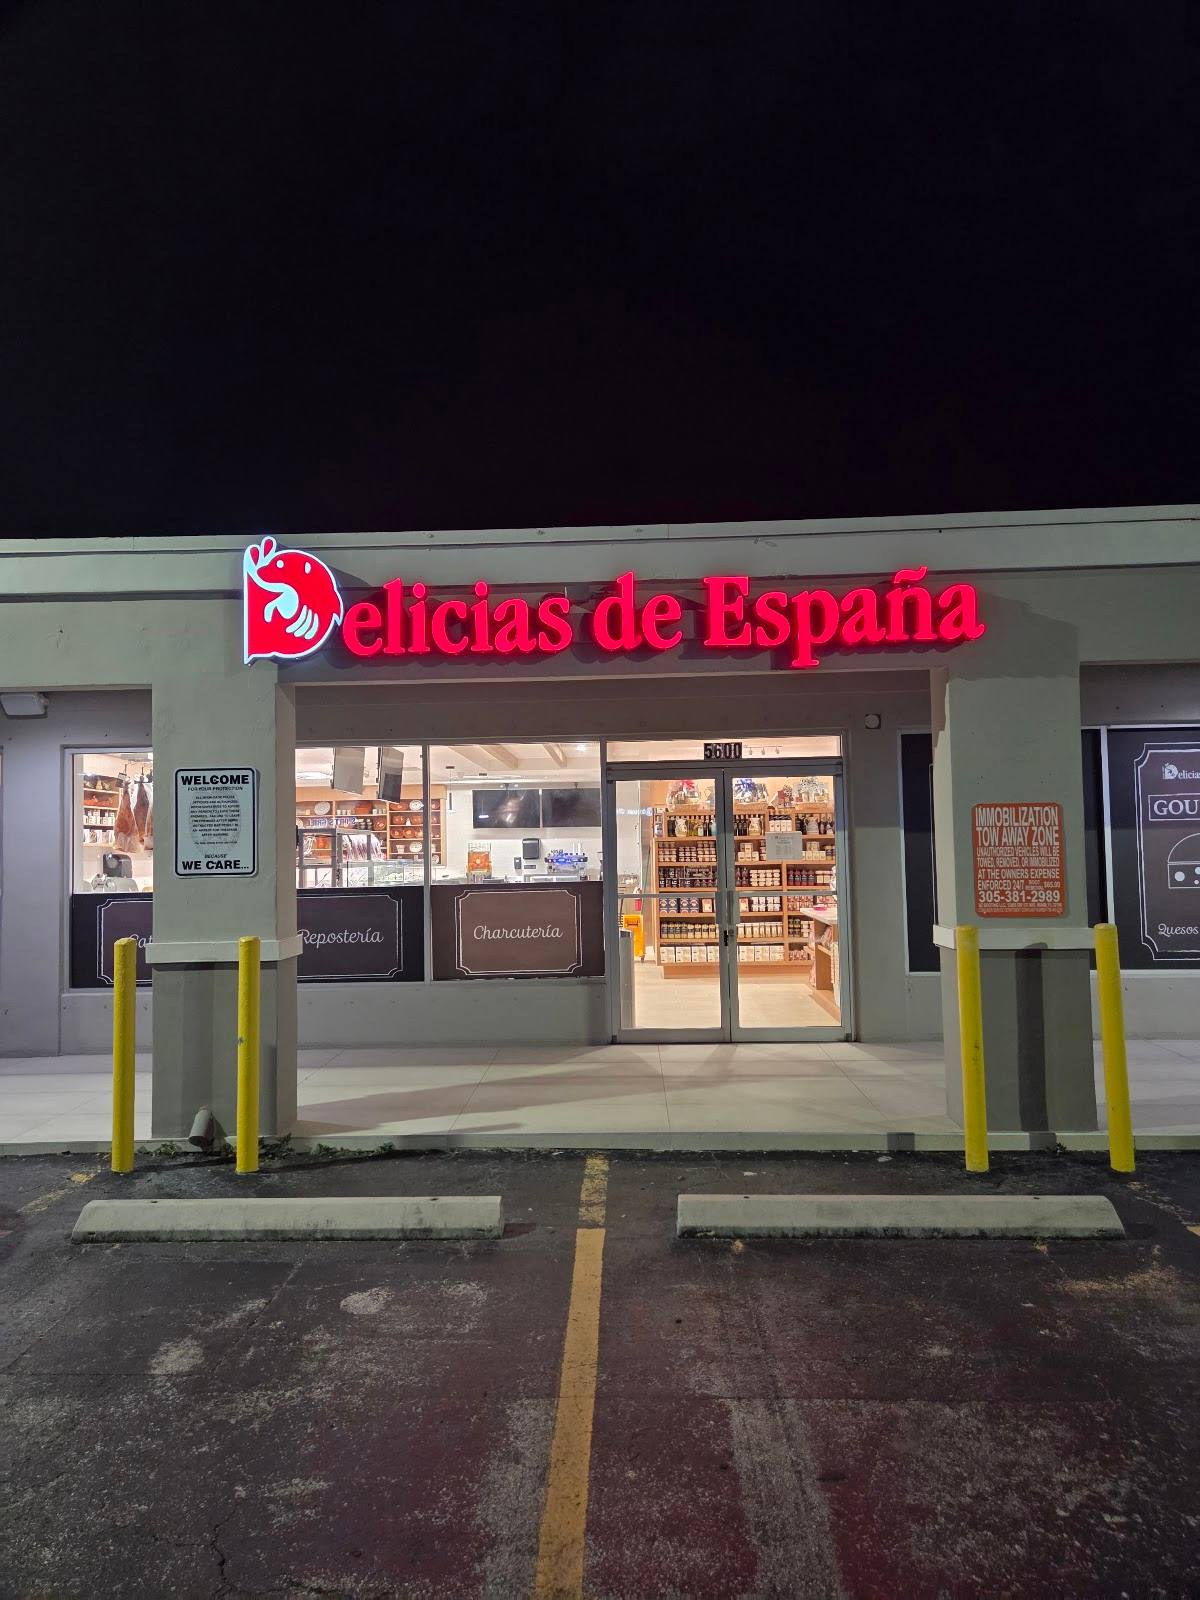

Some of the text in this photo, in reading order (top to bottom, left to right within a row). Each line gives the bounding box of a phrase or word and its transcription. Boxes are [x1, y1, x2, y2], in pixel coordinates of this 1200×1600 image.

[594, 571, 683, 650] de
[703, 566, 985, 668] España
[704, 742, 742, 759] 5600
[181, 775, 250, 786] WELCOME
[975, 806, 1058, 826] IMMOBILIZATION
[976, 825, 1060, 846] TOW AWAY ZONE
[977, 846, 1060, 857] UNAUTHORIZED VEHICLES WILL BE
[182, 860, 250, 870] WE CARE...
[1022, 857, 1029, 867] OR
[1030, 857, 1060, 867] IMMOBILIZED
[978, 868, 1060, 879] AT THE OWNERS EXPENSE
[978, 880, 1012, 891] ENFORCED
[978, 890, 1060, 902] 305-381-2989
[473, 924, 564, 940] Charcutería
[1158, 923, 1199, 938] Quesos
[297, 927, 384, 949] Repostería
